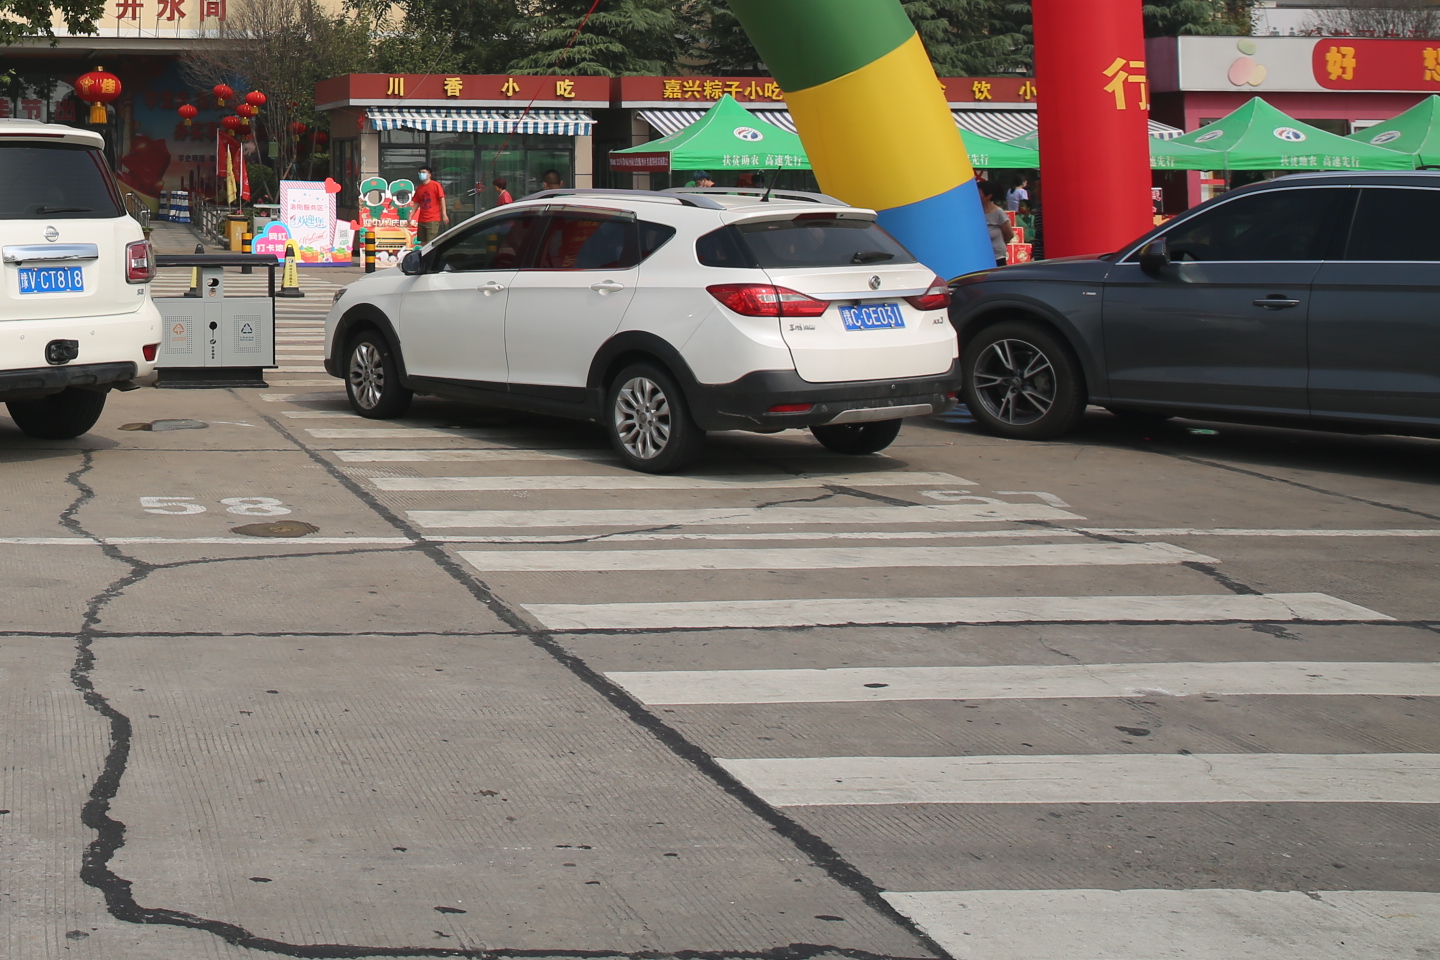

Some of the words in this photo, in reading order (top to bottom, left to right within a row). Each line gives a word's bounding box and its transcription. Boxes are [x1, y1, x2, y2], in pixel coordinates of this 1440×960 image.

[101, 78, 116, 94] 佳
[387, 76, 577, 100] 川香小吃
[662, 79, 784, 101] 嘉兴粽子小吃
[722, 154, 760, 166] 扶贫助农
[765, 154, 802, 166] 高速先行
[1280, 155, 1317, 167] 扶贫助农
[1322, 155, 1360, 168] 高速先行
[289, 203, 324, 212] 洛阳服务区
[268, 232, 287, 241] 网红
[256, 243, 286, 253] 打卡地
[140, 496, 292, 516] 58
